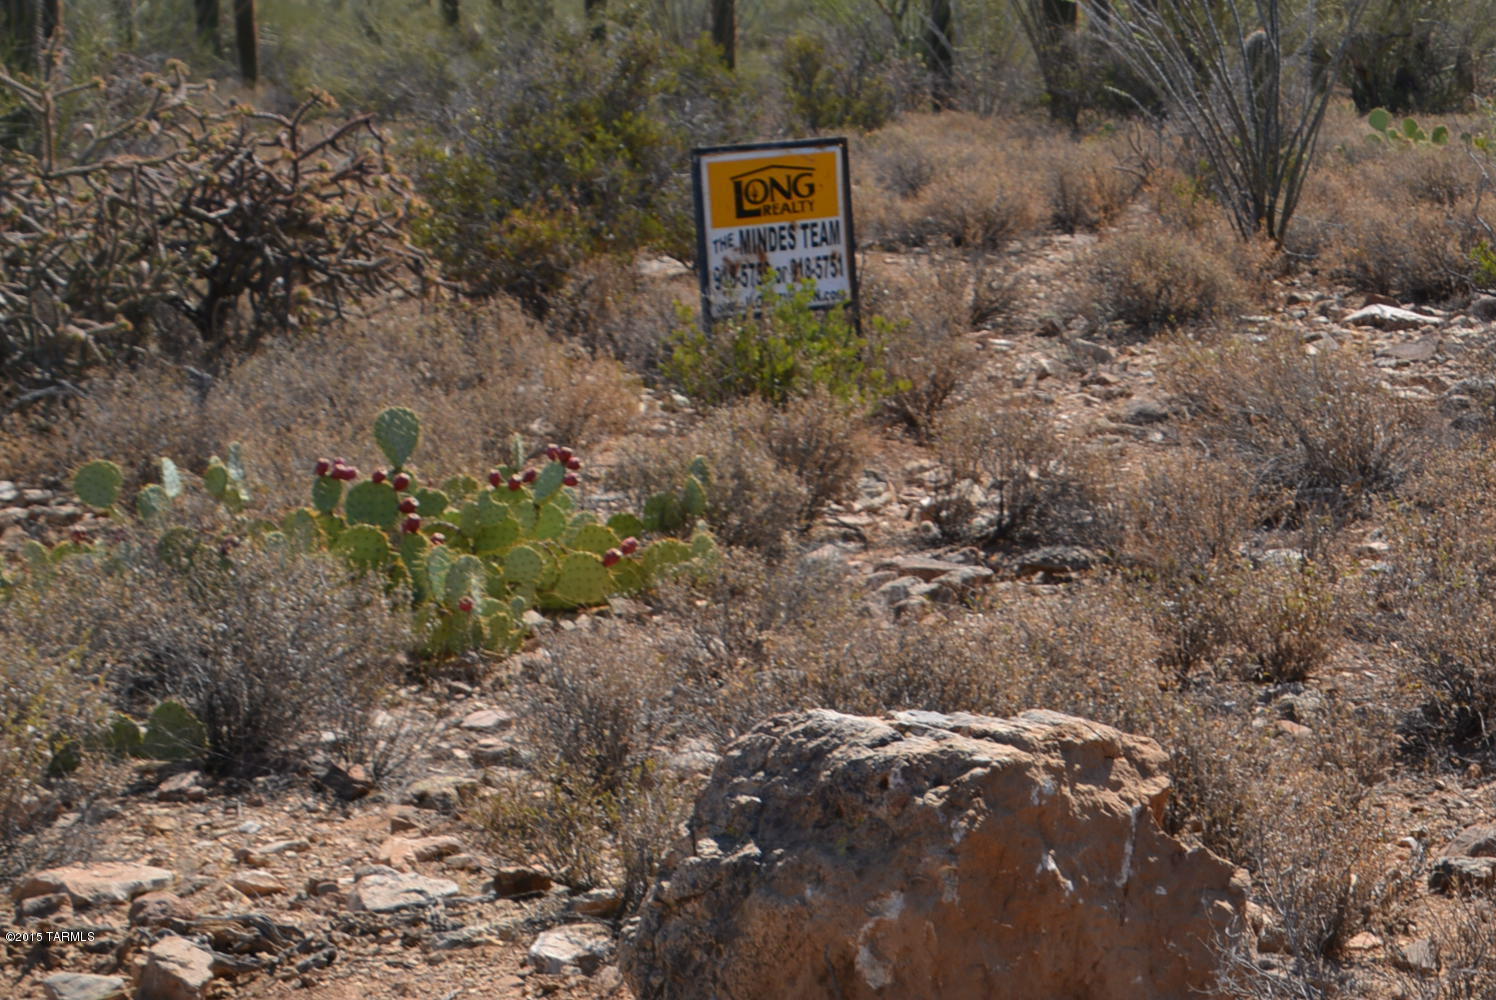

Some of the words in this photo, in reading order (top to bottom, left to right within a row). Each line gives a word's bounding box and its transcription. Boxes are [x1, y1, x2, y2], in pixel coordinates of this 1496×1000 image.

[732, 172, 815, 219] LONG
[762, 200, 814, 216] REALTY
[712, 232, 734, 254] THE
[738, 225, 797, 255] MINDES
[801, 220, 841, 249] TEAM
